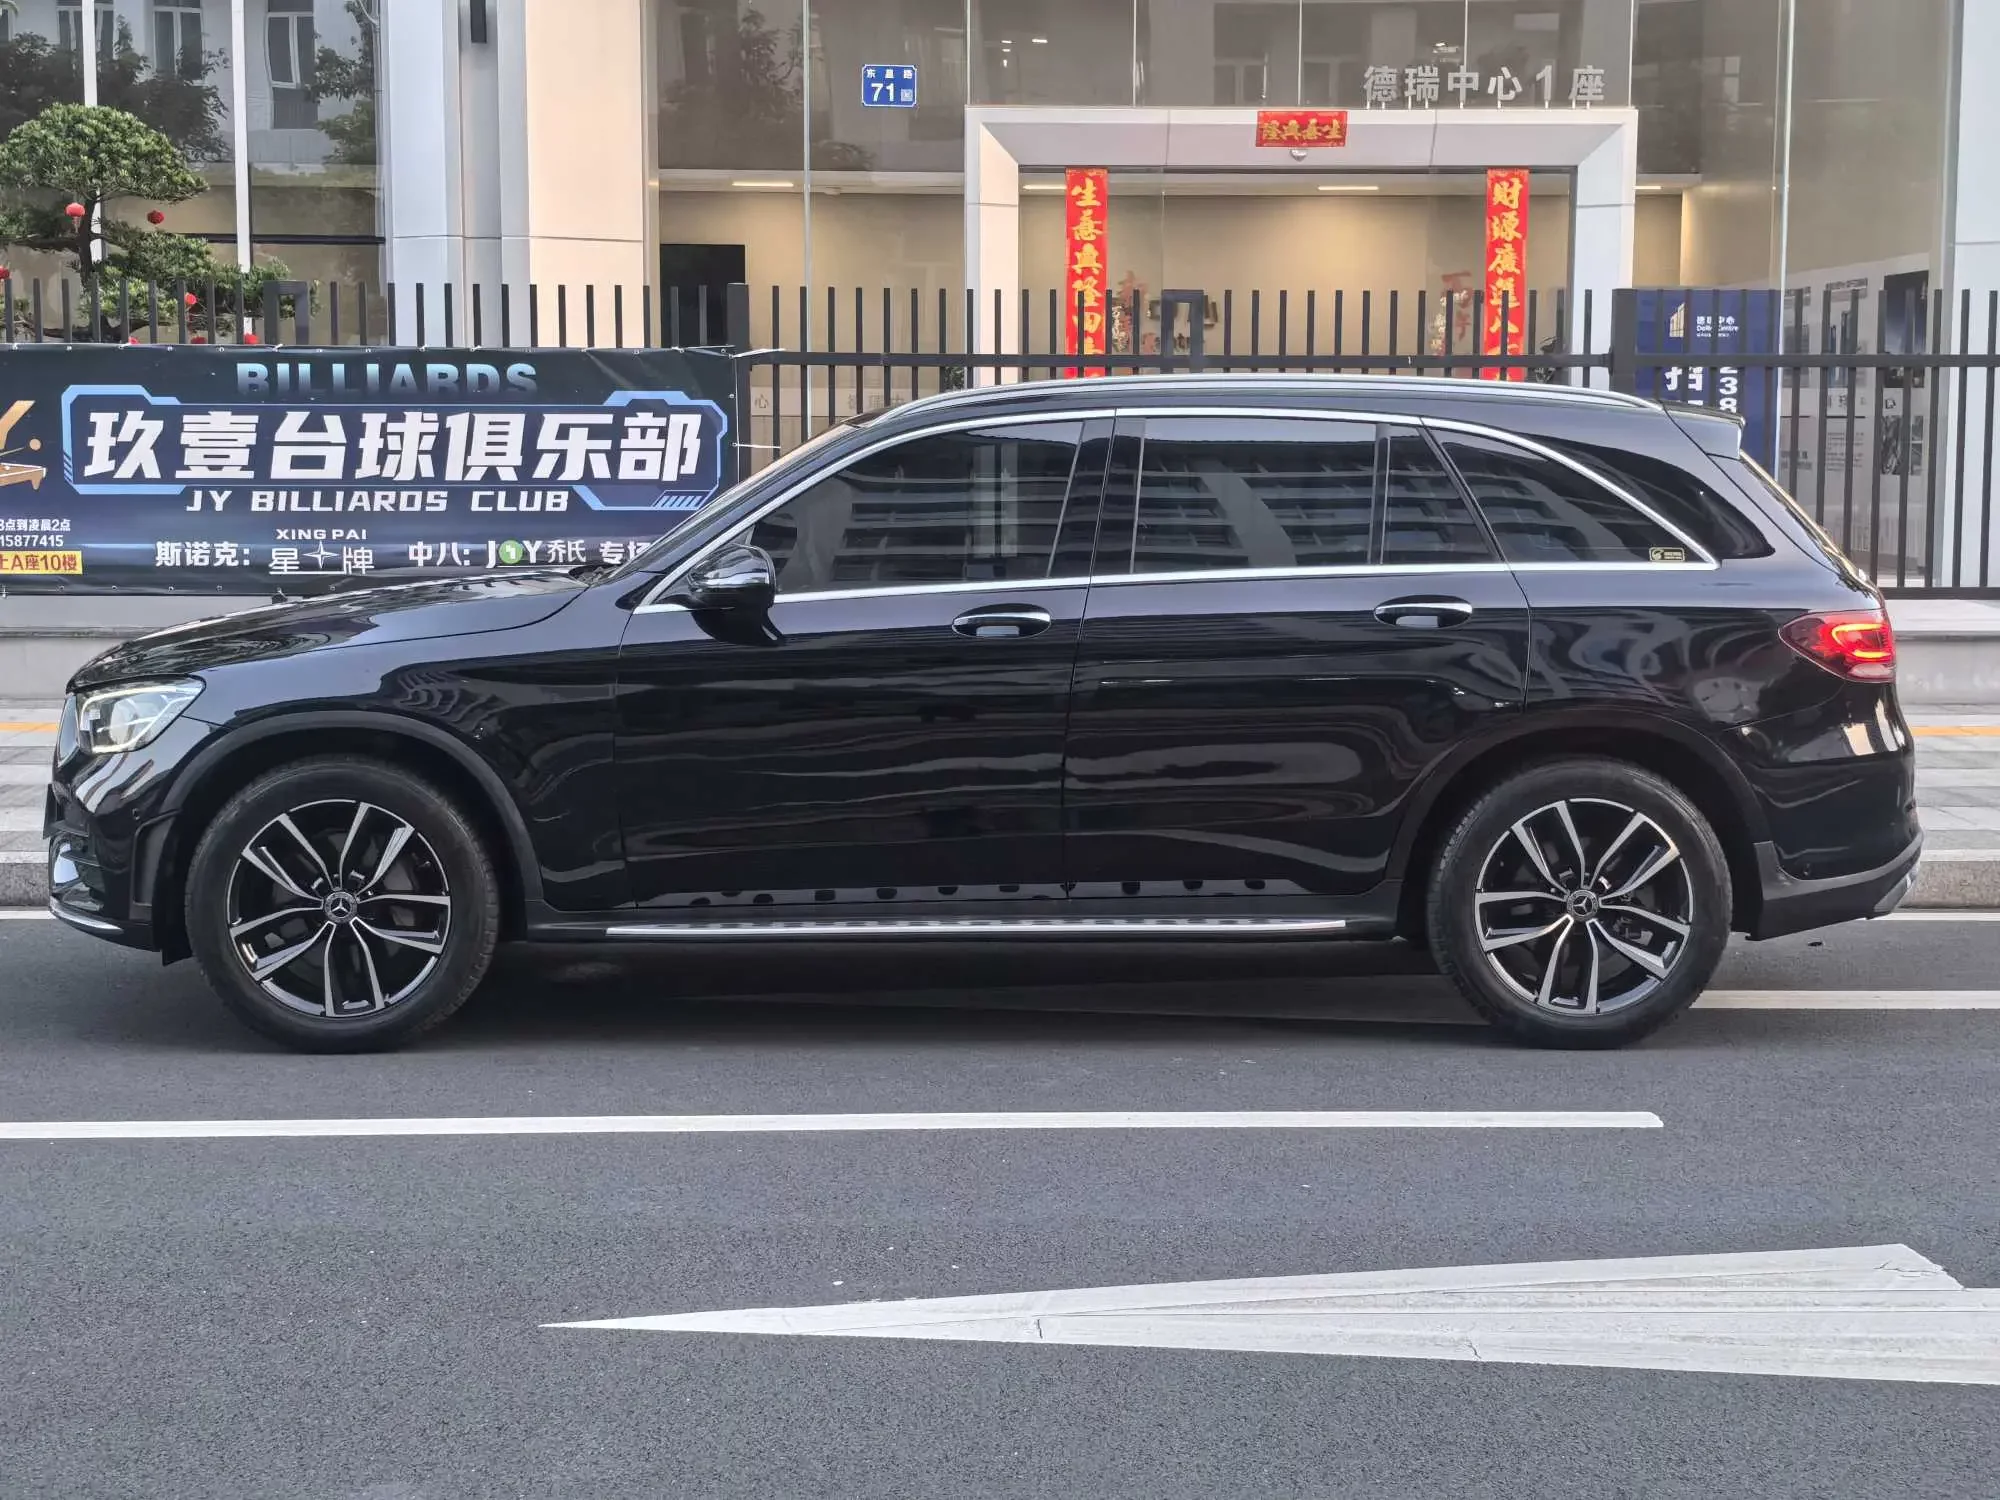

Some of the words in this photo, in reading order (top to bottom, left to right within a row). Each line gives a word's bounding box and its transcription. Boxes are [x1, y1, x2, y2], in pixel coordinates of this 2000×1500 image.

[871, 82, 895, 102] 71
[1363, 64, 1605, 103] 德瑞中心1座
[236, 362, 538, 396] BILLIARDS
[84, 410, 702, 481] 玖壹台球俱乐部
[186, 490, 233, 512] JY
[250, 490, 448, 512] BILLIARDS
[470, 490, 568, 512] CLUB
[276, 529, 327, 540] XING
[332, 529, 367, 540] PAI
[547, 540, 587, 564] 乔氏
